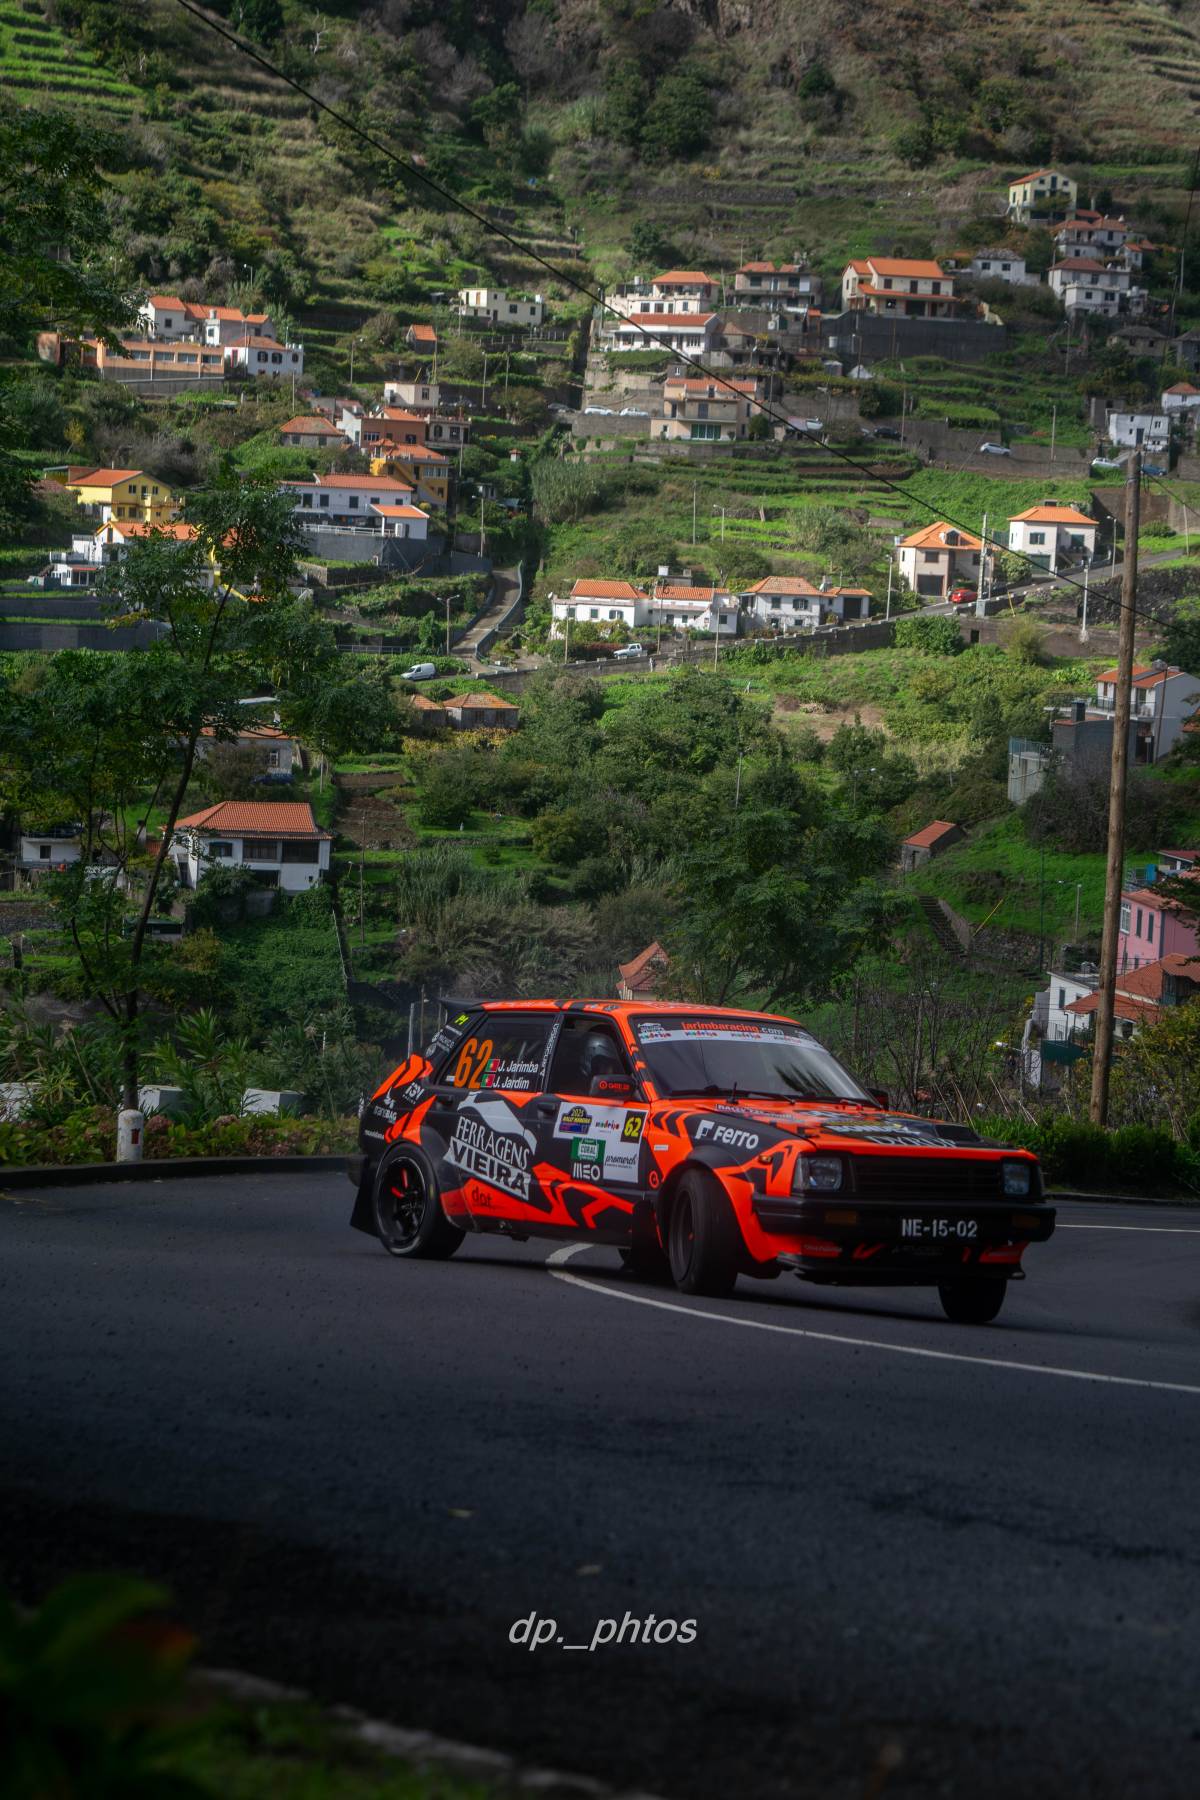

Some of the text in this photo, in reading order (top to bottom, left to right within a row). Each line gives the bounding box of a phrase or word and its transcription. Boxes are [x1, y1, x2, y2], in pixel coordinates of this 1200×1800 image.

[454, 1038, 493, 1089] 62
[498, 1060, 539, 1073] J. Jarimba
[493, 1077, 529, 1089] J. Jardim
[623, 1117, 641, 1137] 62
[455, 1116, 530, 1170] FERRAGENS
[451, 1139, 527, 1197] VIEIRA
[573, 1162, 600, 1181] MEO
